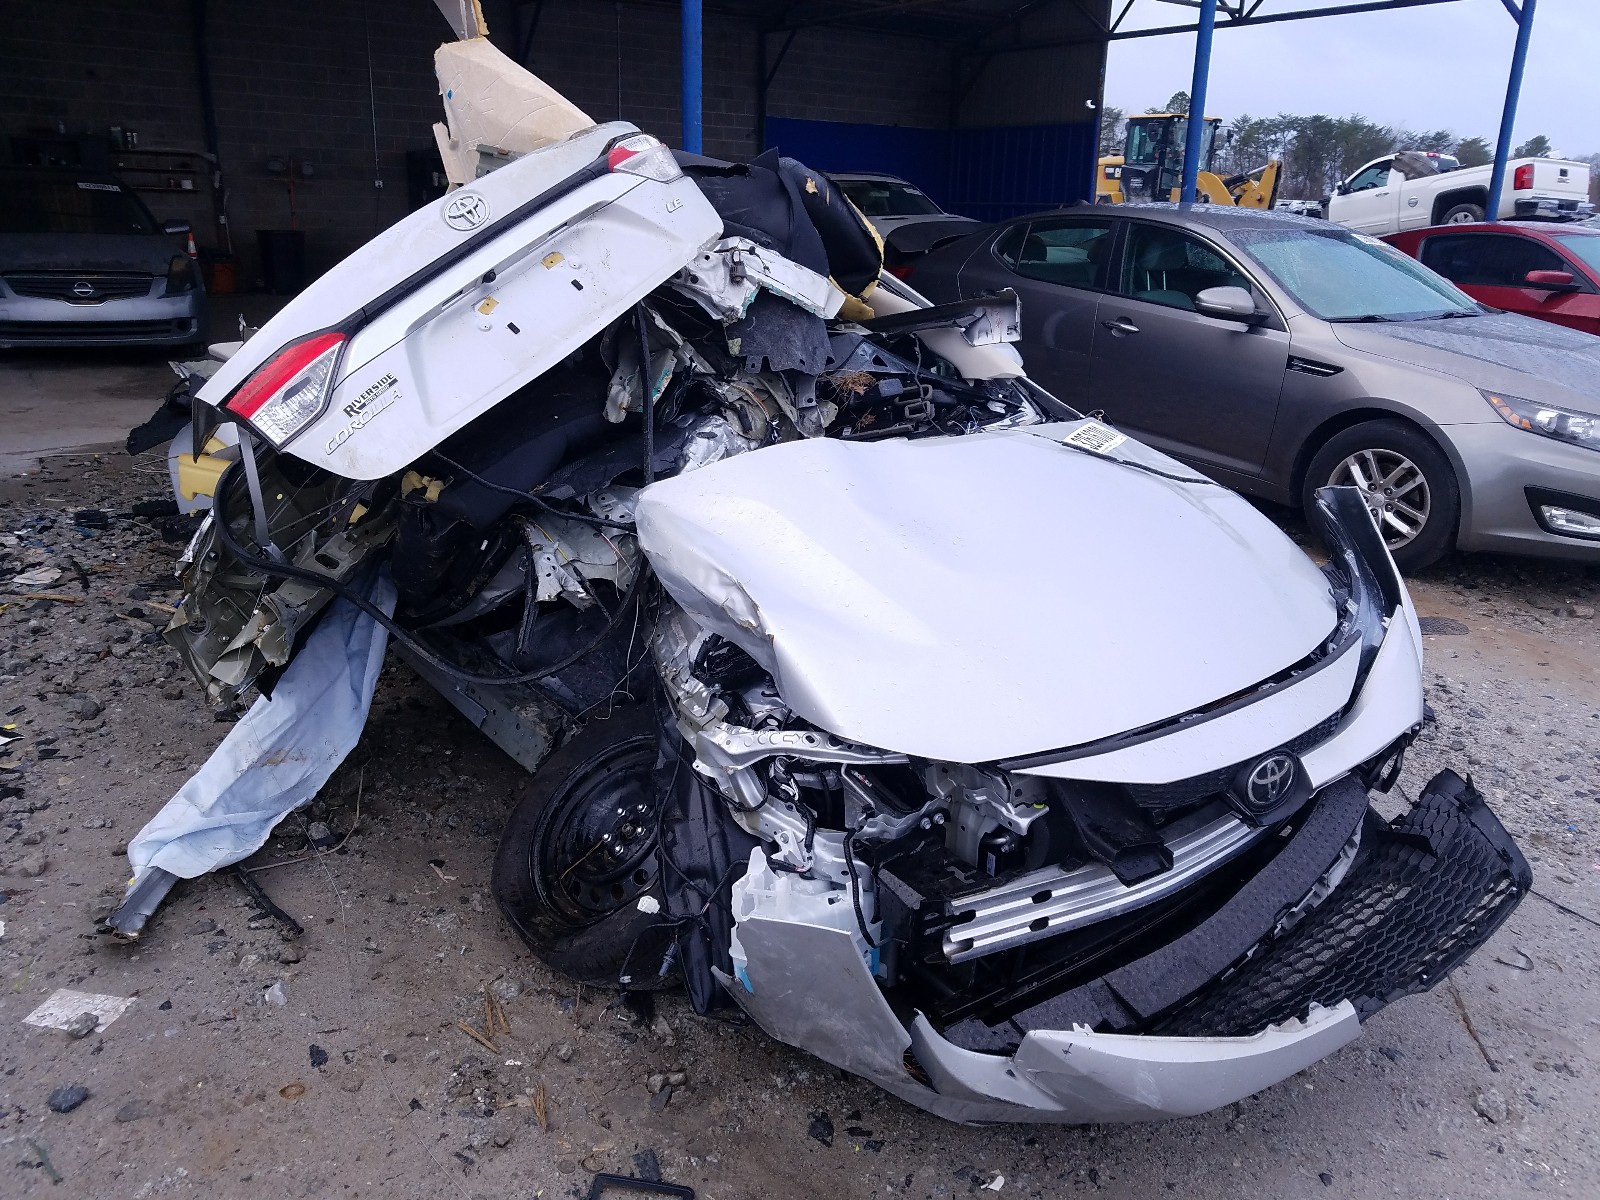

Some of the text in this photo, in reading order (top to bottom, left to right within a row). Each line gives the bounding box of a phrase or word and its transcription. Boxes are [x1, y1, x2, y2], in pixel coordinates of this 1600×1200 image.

[666, 198, 684, 213] LE
[343, 373, 395, 418] RIVERSIDE
[325, 389, 402, 455] COROLLA
